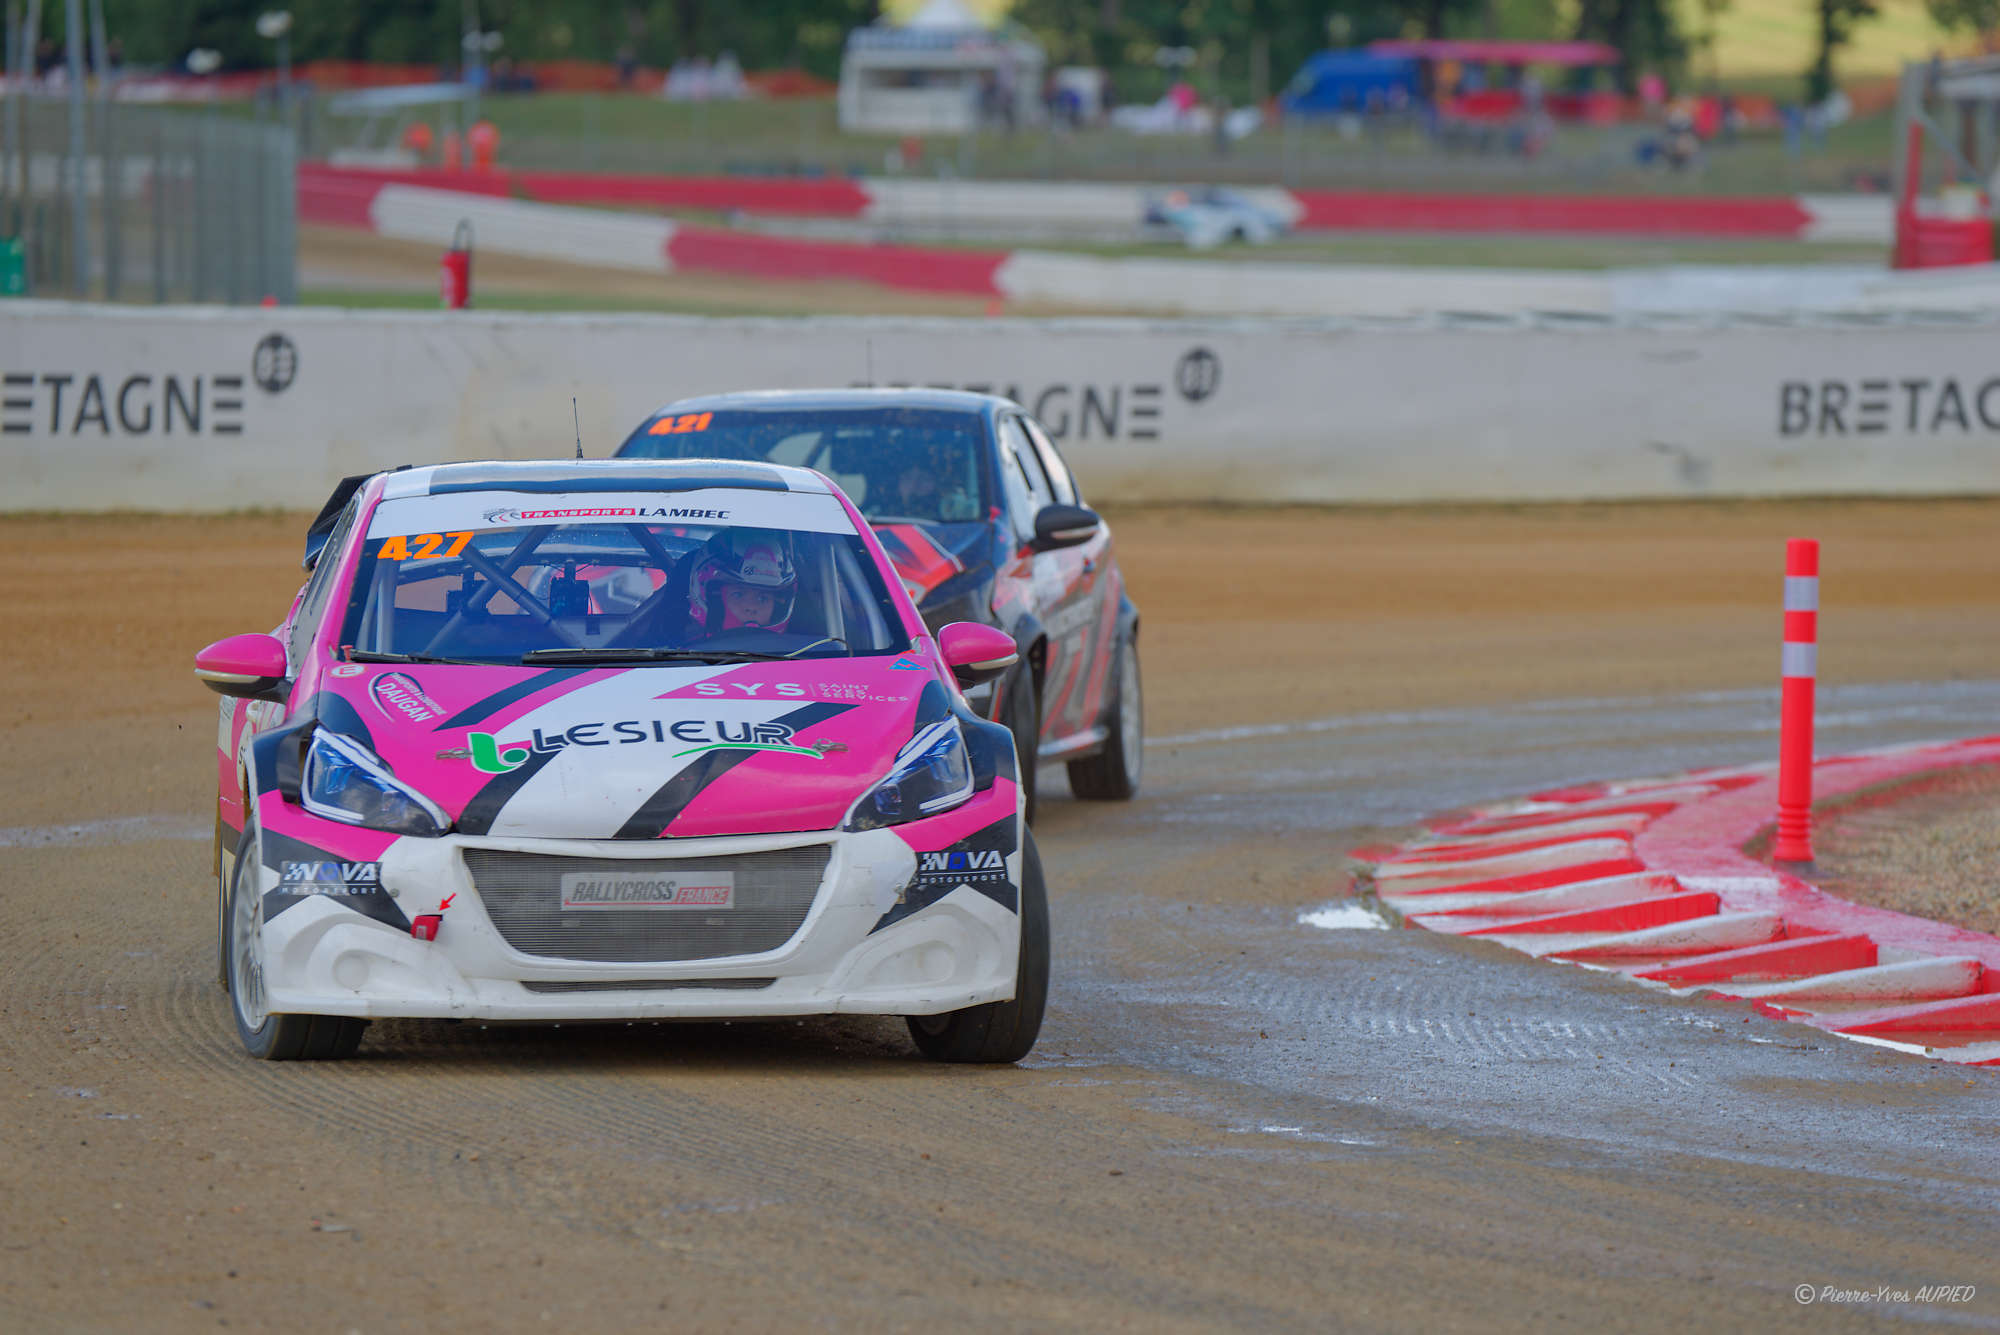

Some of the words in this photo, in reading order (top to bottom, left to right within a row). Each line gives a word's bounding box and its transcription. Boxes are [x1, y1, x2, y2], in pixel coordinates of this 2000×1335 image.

[648, 411, 713, 436] 421
[523, 509, 634, 518] TRANSPORTS
[639, 507, 731, 519] LAMBEC
[377, 531, 474, 561] 427
[374, 682, 435, 723] DAUGAN
[694, 683, 806, 697] SYS
[531, 719, 797, 752] LESIEUR
[573, 881, 677, 902] RALLYCROSS
[678, 887, 729, 904] FRANCE
